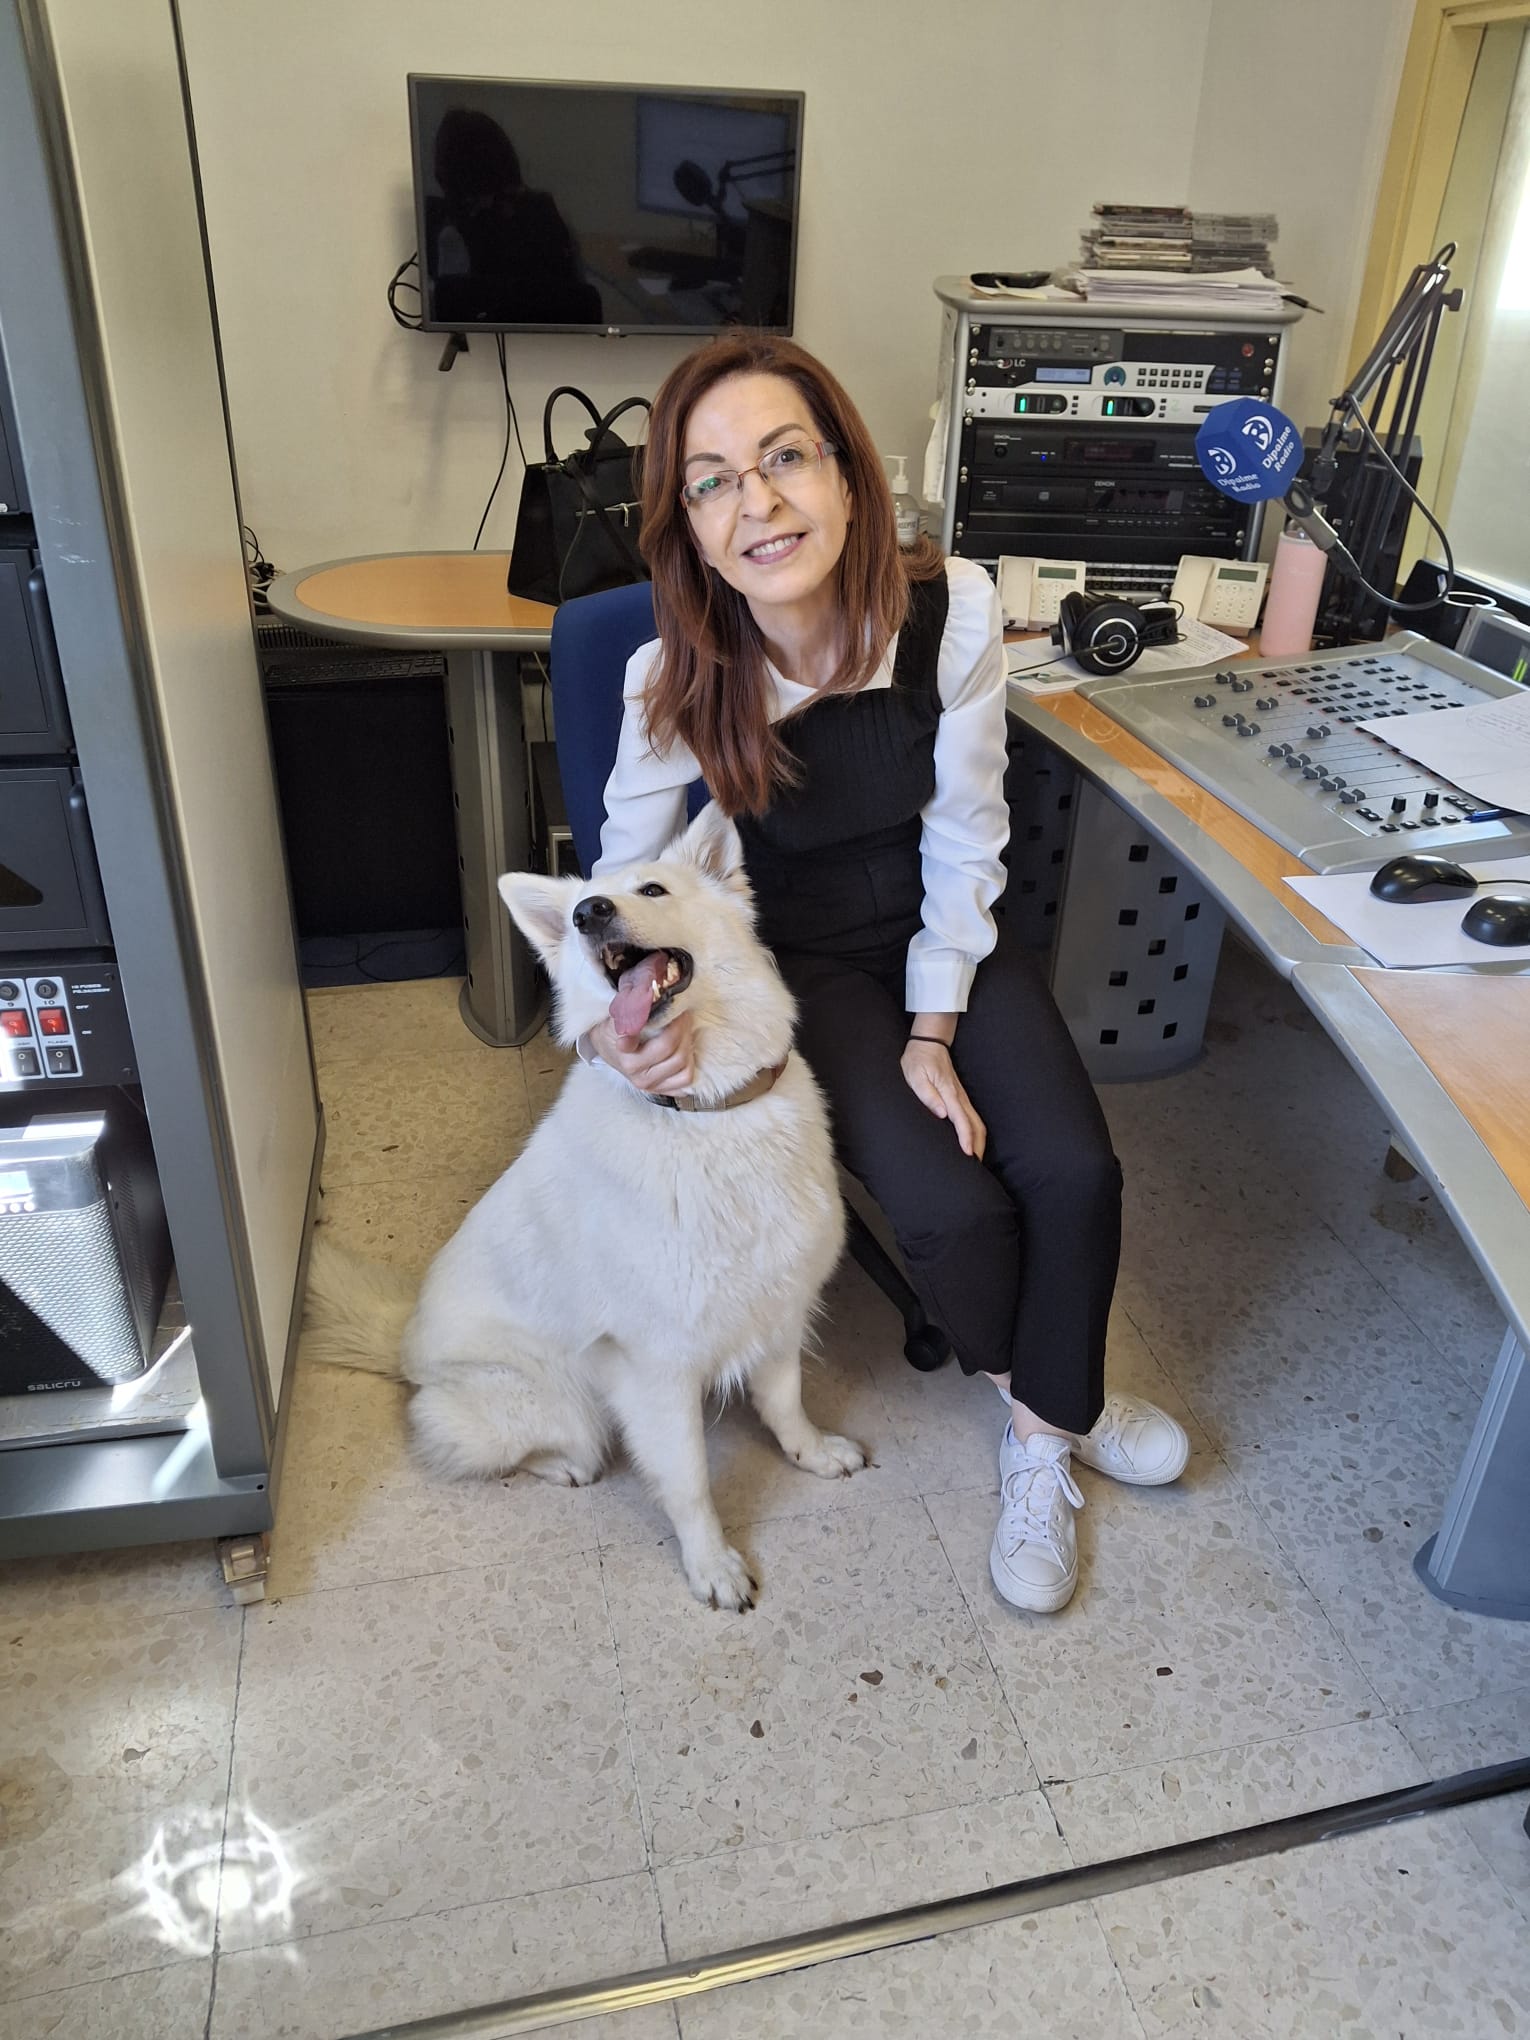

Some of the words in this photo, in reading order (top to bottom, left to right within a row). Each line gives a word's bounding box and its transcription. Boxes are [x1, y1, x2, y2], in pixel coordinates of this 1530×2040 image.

[1262, 426, 1291, 469] Dipalme
[1274, 442, 1294, 472] Radio
[1217, 474, 1259, 486] Dipalme
[1232, 483, 1261, 492] Radio
